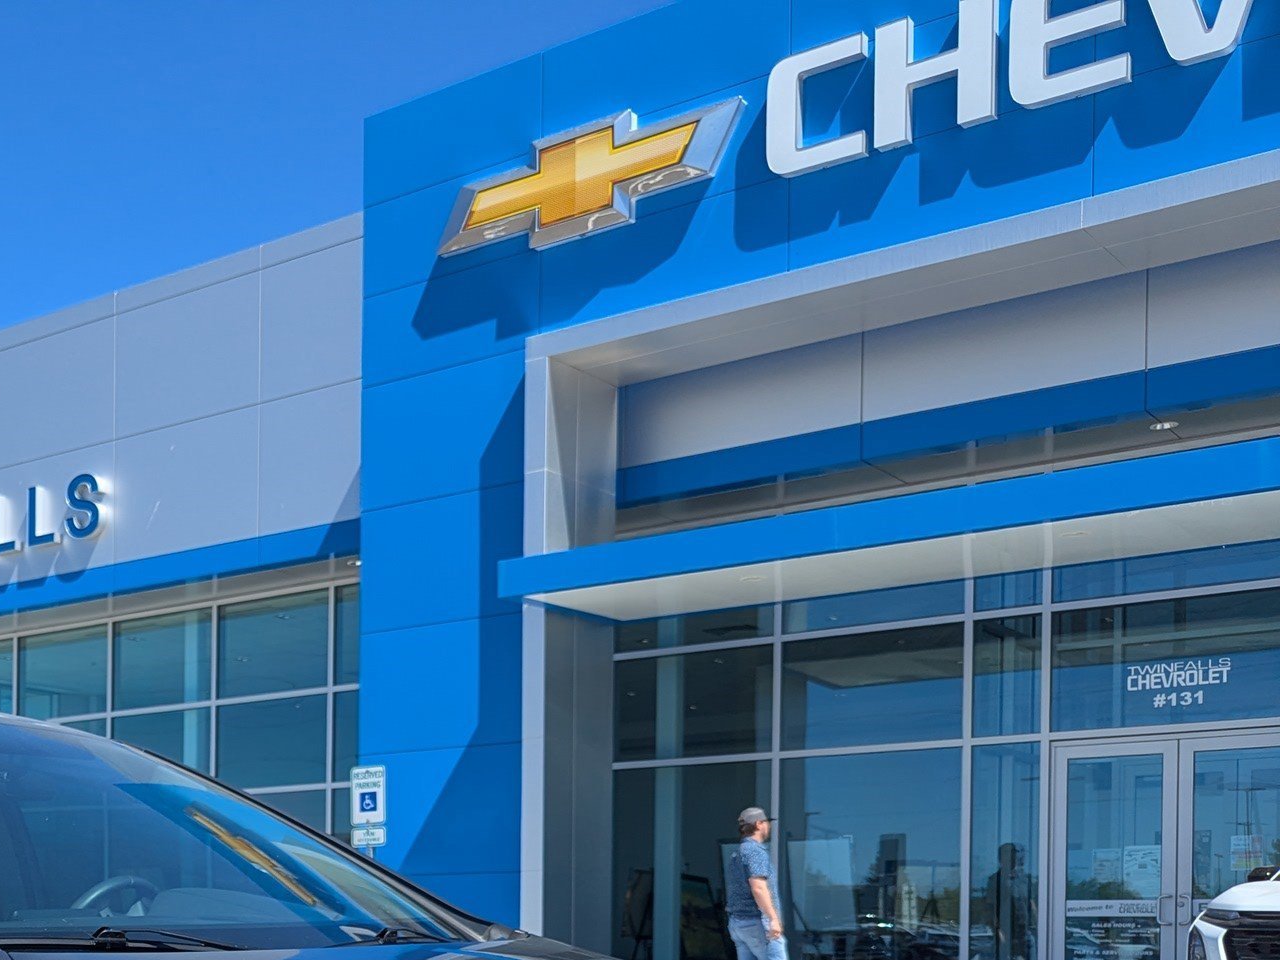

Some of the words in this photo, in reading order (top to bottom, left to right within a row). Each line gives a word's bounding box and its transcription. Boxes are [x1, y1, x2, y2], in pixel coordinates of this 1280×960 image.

[1127, 657, 1231, 676] TWINFALLS
[1127, 667, 1231, 691] CHEVROLET
[1153, 690, 1204, 708] #131
[353, 770, 383, 780] RESERVED
[354, 781, 381, 790] PARKING
